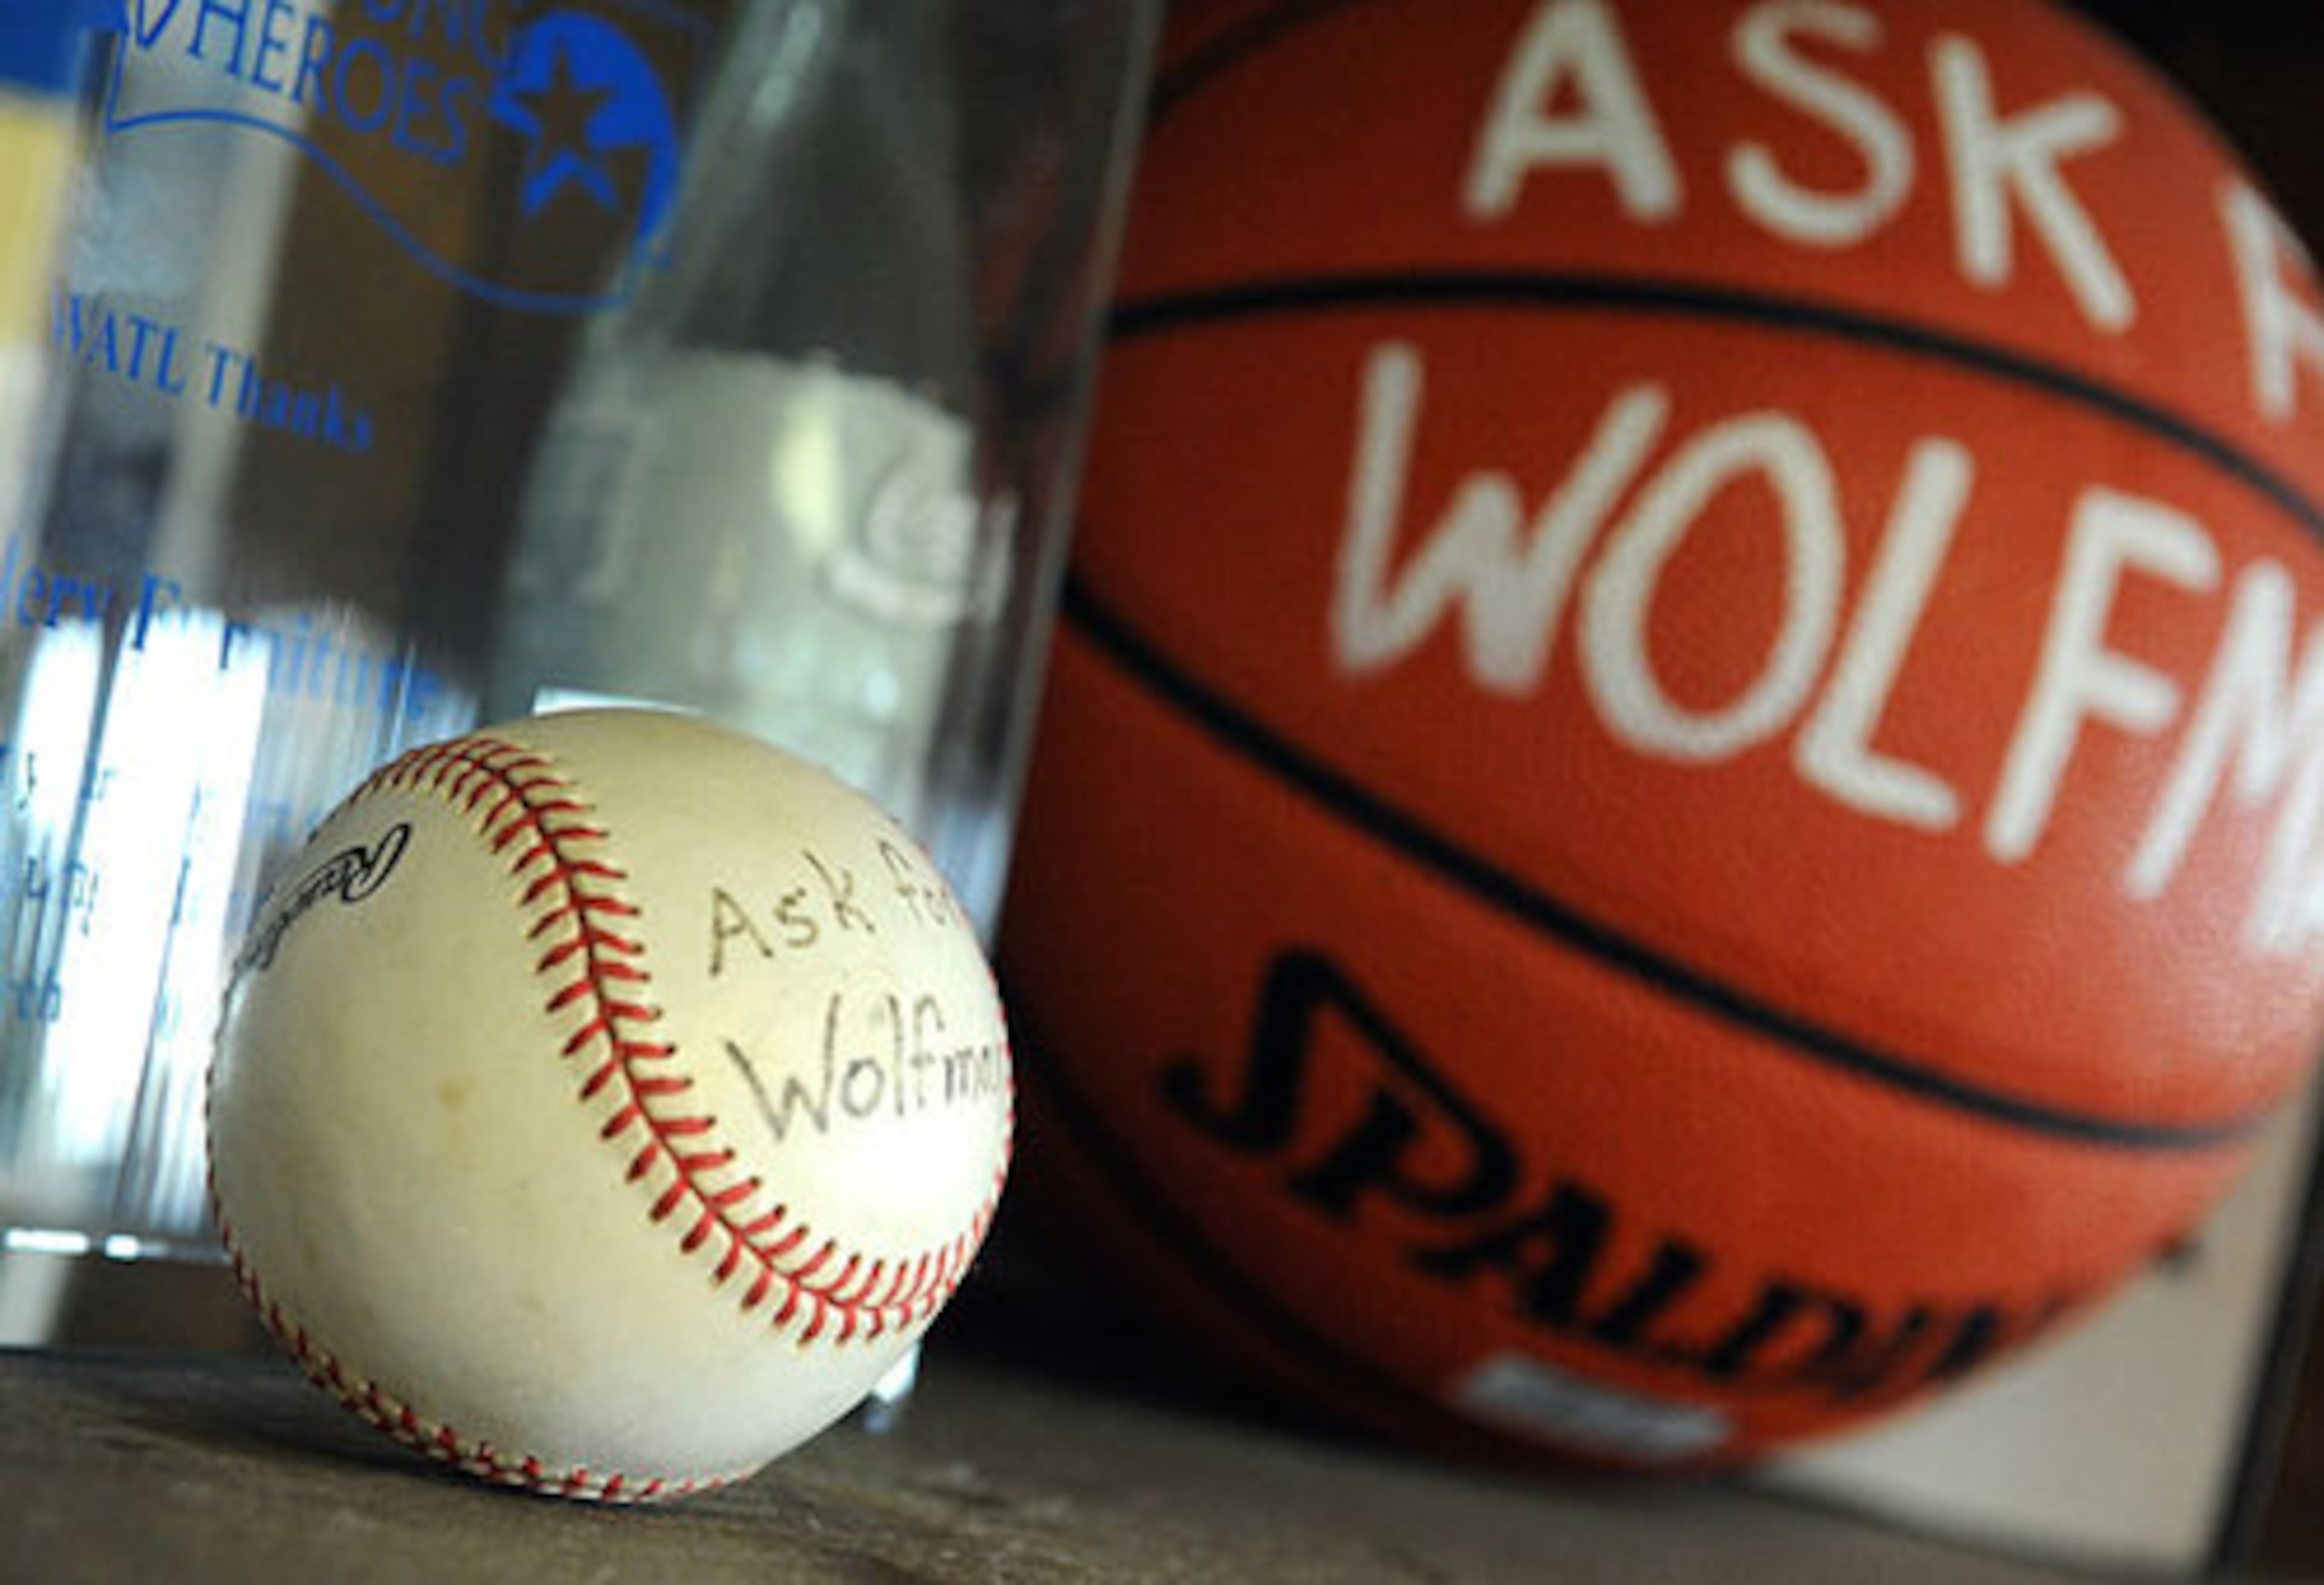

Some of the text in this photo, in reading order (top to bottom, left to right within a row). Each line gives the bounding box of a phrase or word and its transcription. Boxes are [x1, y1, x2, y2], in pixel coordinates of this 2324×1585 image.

[186, 0, 478, 166] HEROES
[1460, 0, 2139, 336] ASK
[205, 340, 374, 454] Thanks
[708, 847, 876, 979] Ask
